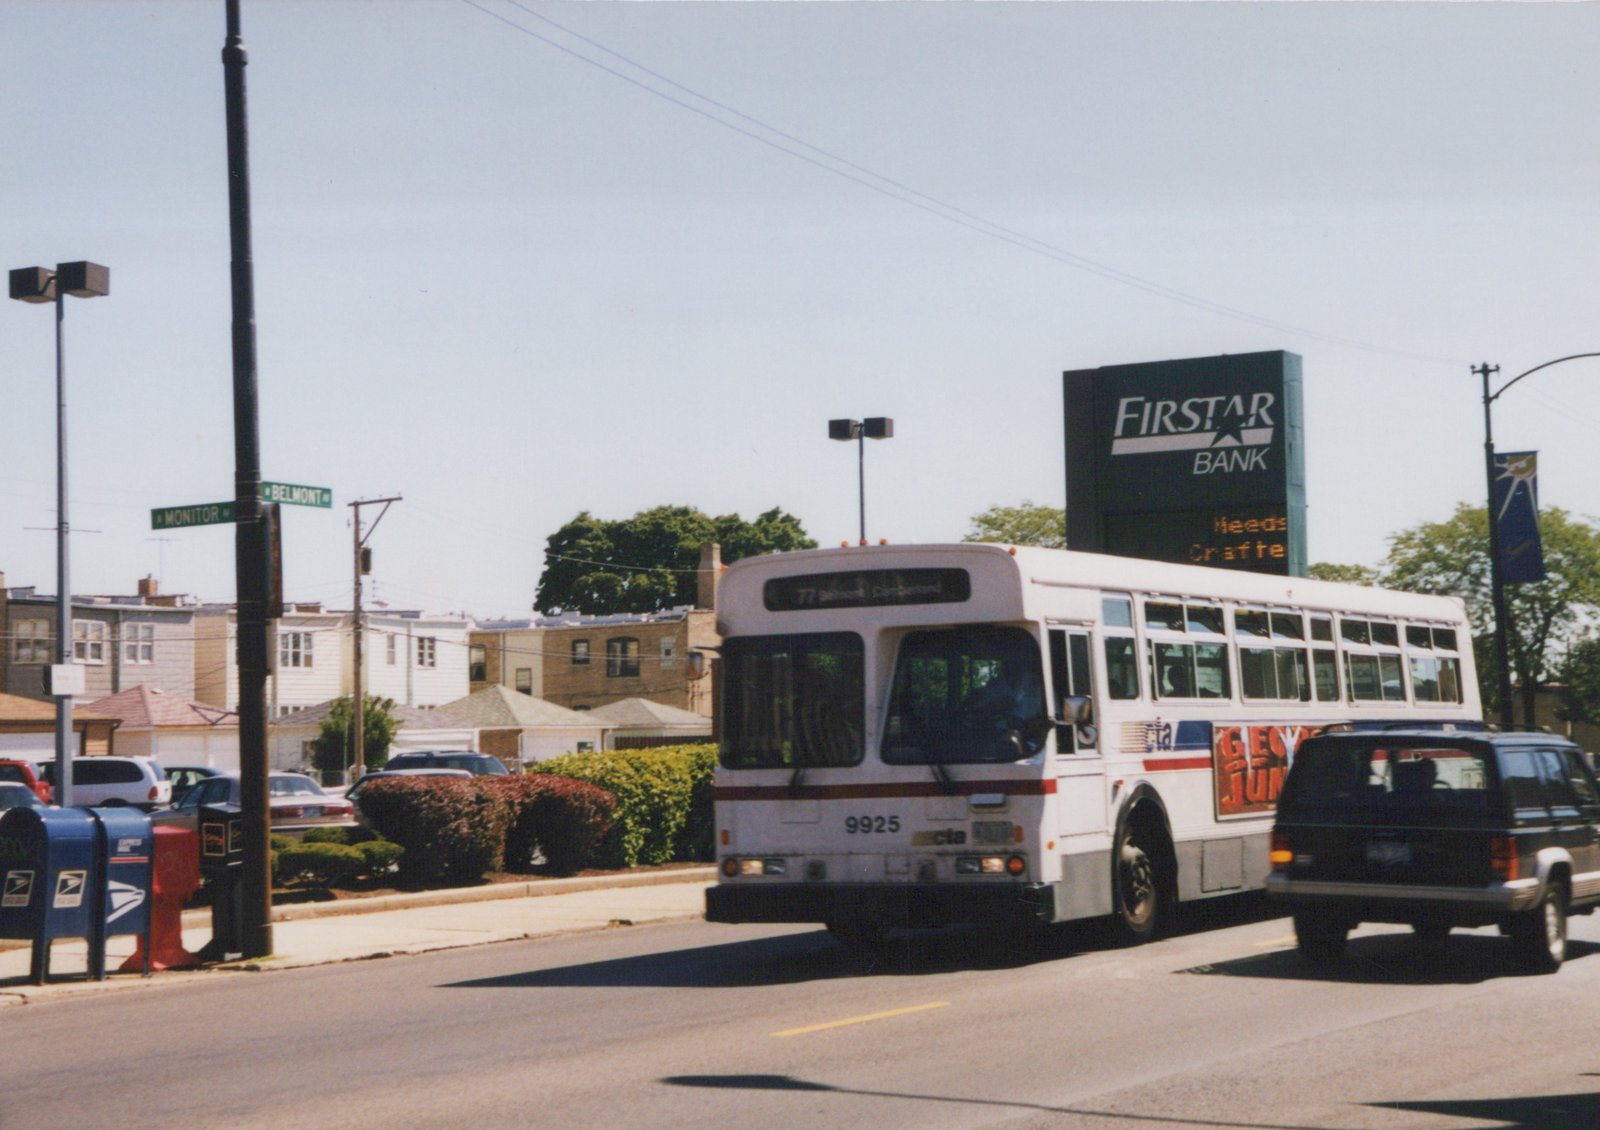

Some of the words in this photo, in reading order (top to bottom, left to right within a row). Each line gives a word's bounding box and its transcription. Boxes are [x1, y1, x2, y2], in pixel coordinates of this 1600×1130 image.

[1114, 392, 1275, 437] FIRSTAR
[1193, 448, 1270, 475] BANK
[272, 484, 322, 505] BELMONT
[165, 506, 220, 526] MONITOR
[1214, 515, 1288, 535] Needs
[845, 815, 901, 834] 9925
[935, 828, 967, 846] cta
